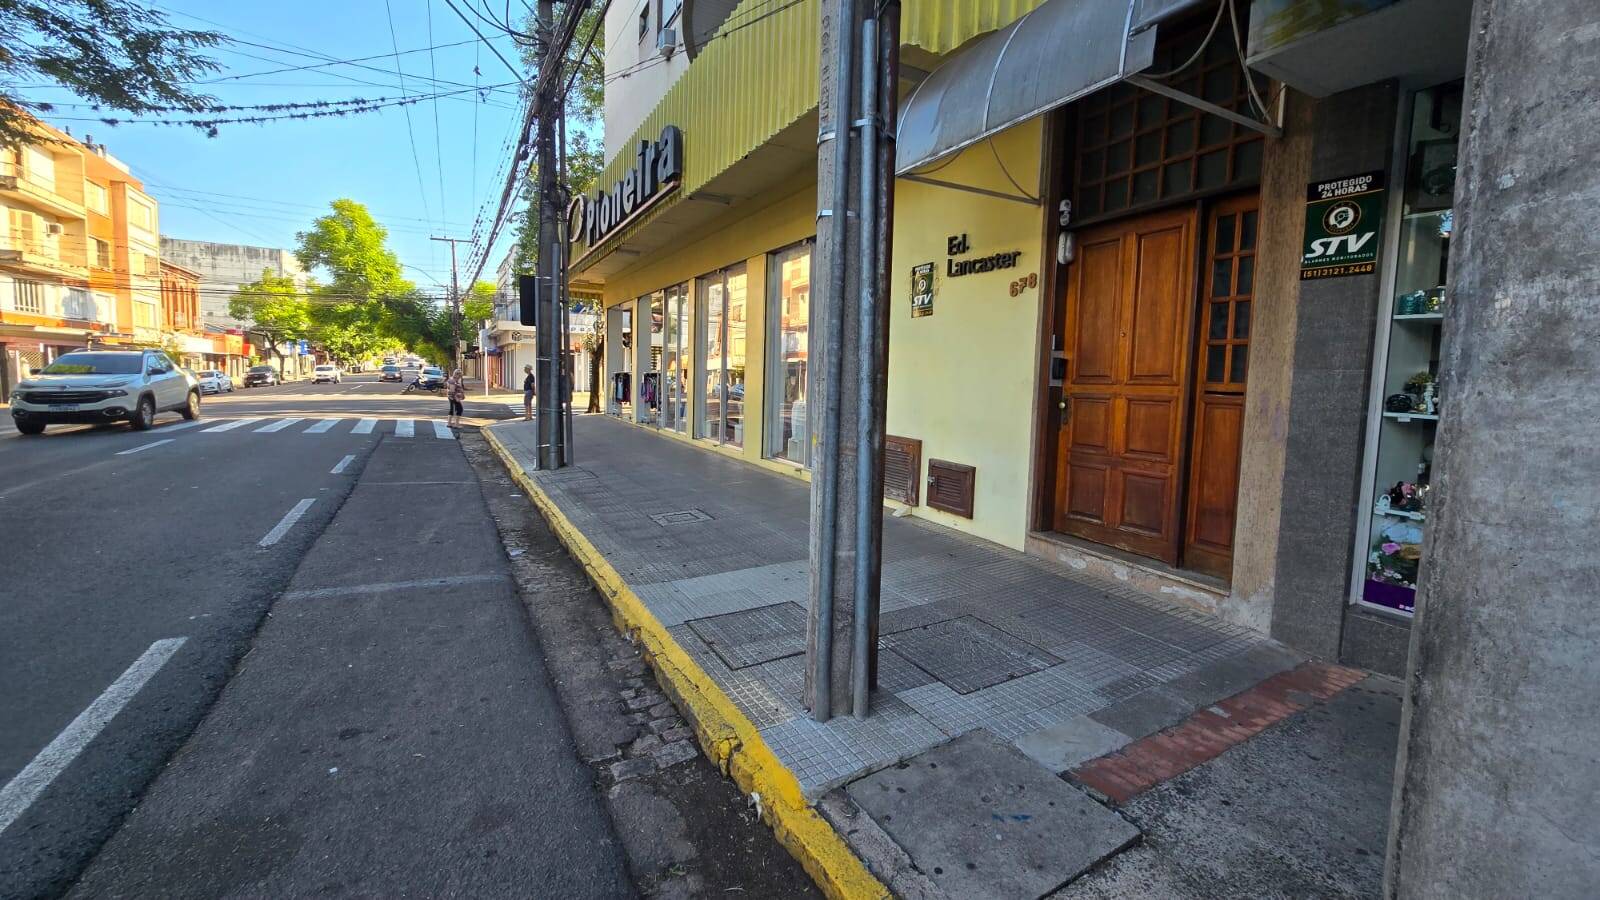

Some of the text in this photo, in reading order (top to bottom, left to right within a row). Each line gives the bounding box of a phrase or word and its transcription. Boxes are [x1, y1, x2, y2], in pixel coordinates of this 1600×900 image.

[586, 125, 682, 247] pioneira
[1318, 175, 1372, 192] PROTEGIDO
[1321, 184, 1368, 199] 24 HORAS
[947, 233, 970, 256] Ed.
[1304, 231, 1375, 258] STV
[947, 251, 1022, 278] Lancaster
[1009, 272, 1038, 297] 678
[912, 292, 932, 306] STV
